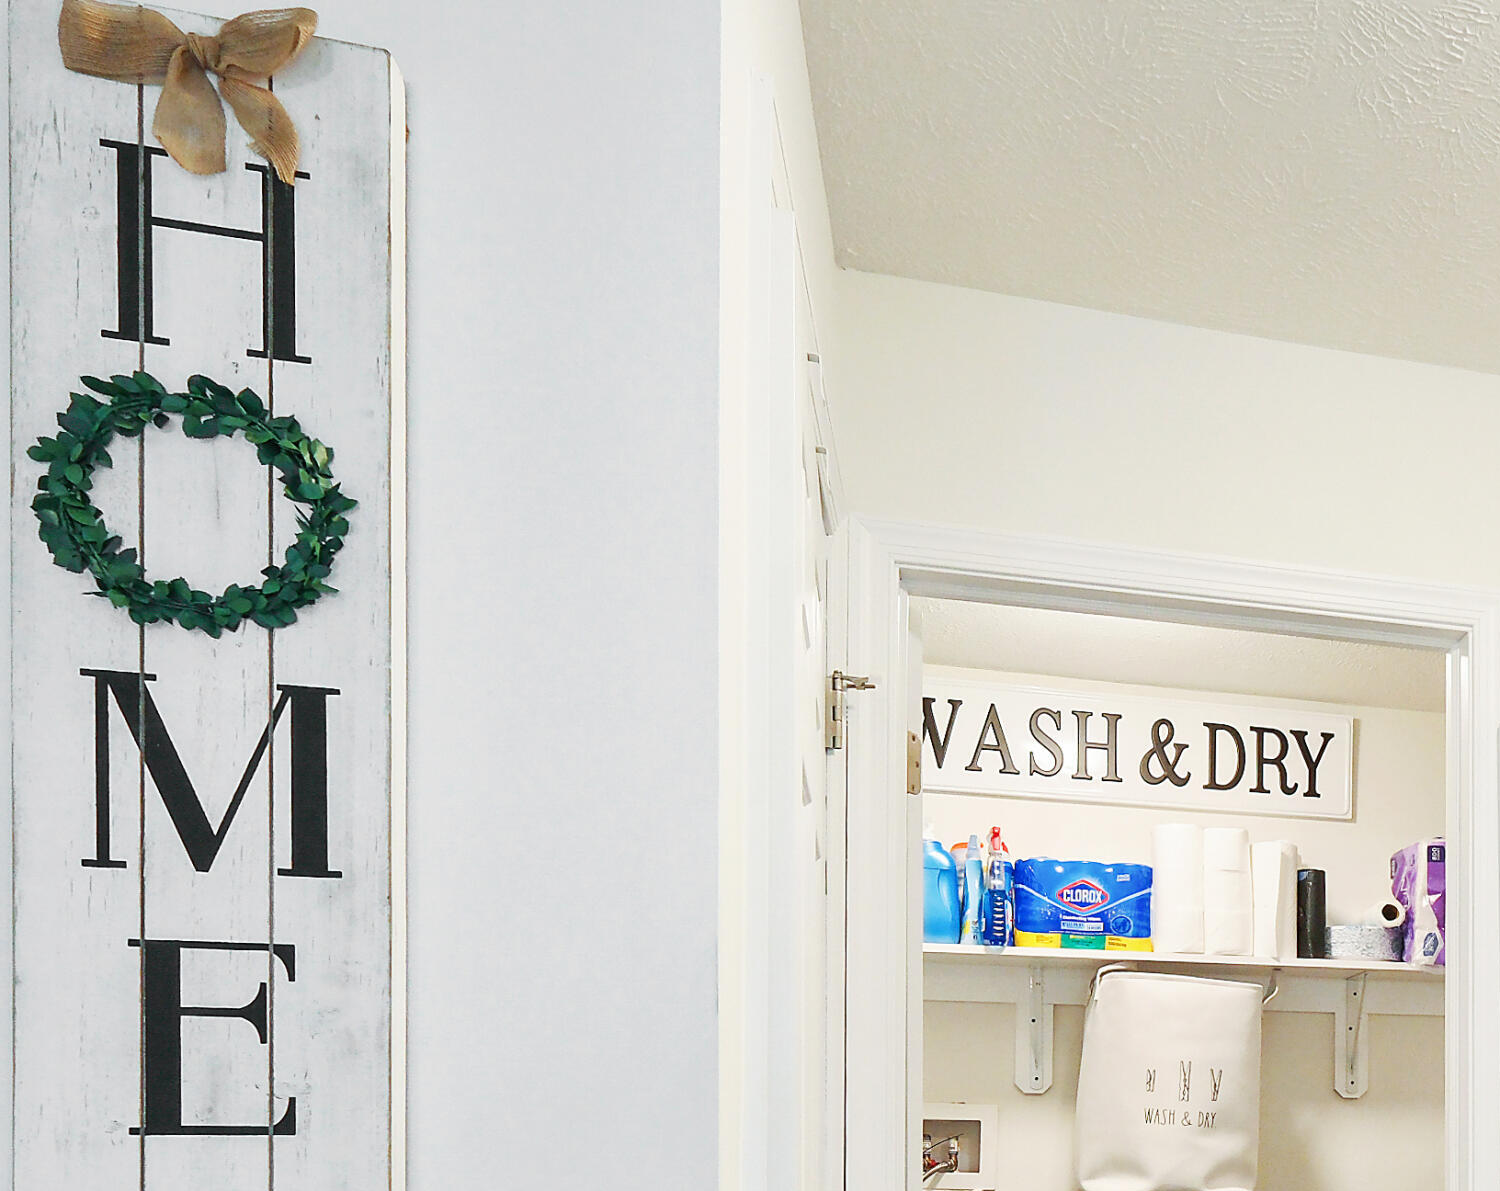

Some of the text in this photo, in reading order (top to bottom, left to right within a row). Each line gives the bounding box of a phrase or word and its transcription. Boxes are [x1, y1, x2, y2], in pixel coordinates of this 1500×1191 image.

[921, 697, 1335, 798] WASH & DRY
[1063, 889, 1103, 904] CLOROX
[1144, 1107, 1176, 1126] WASH
[1181, 1111, 1192, 1127] &
